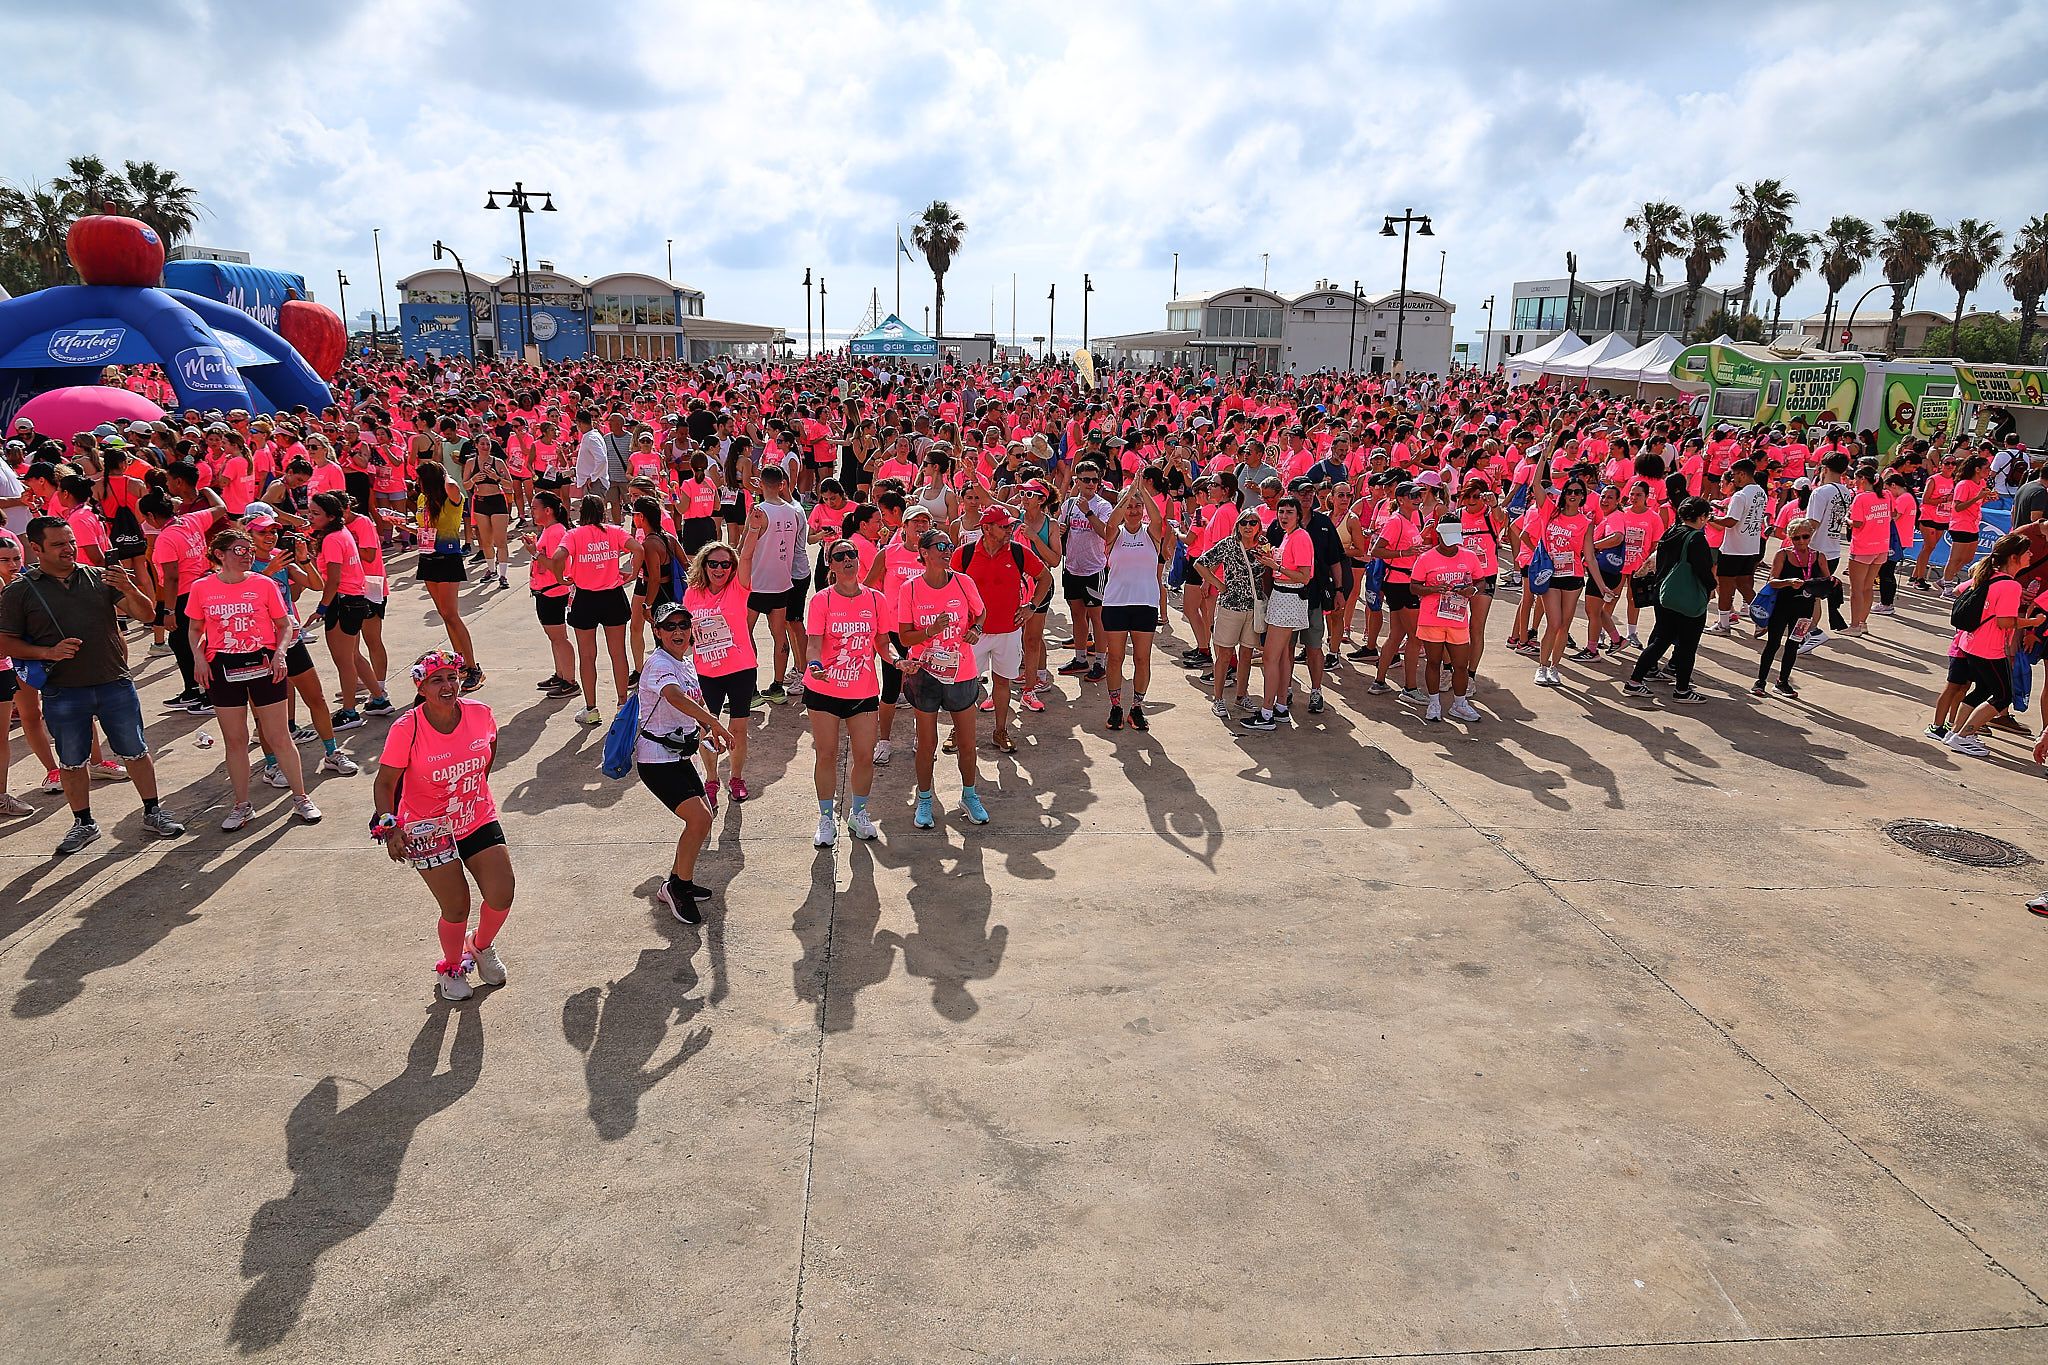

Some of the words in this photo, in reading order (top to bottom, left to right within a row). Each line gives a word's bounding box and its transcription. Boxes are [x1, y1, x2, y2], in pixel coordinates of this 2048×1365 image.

[54, 335, 117, 353] Marlene
[1790, 368, 1840, 383] CUIDARSE
[1974, 371, 2006, 379] CUIDARSE
[192, 381, 223, 389] TOCHTER
[1795, 384, 1806, 396] ES
[1809, 383, 1830, 396] UNA
[1977, 380, 1988, 389] ES
[1990, 380, 2011, 390] UNA
[1980, 391, 2019, 402] GOZADA
[1786, 397, 1826, 410] GOZADA
[1865, 511, 1890, 520] IMPARABLE
[1547, 523, 1572, 538] CARRERA
[587, 541, 610, 552] SOMOS
[579, 550, 619, 562] IMPARABLES
[898, 566, 926, 576] CARRE
[209, 603, 254, 615] CARRERA
[235, 617, 249, 632] DE
[920, 612, 960, 626] CARRA
[832, 622, 871, 633] CARRERA
[943, 626, 955, 640] DE
[851, 635, 863, 650] DE
[702, 649, 728, 663] MUJER
[828, 668, 860, 681] MUJER
[428, 752, 452, 763] OYSHO
[432, 755, 487, 782] CARRERA
[463, 773, 479, 794] DE
[452, 815, 475, 831] UJER
